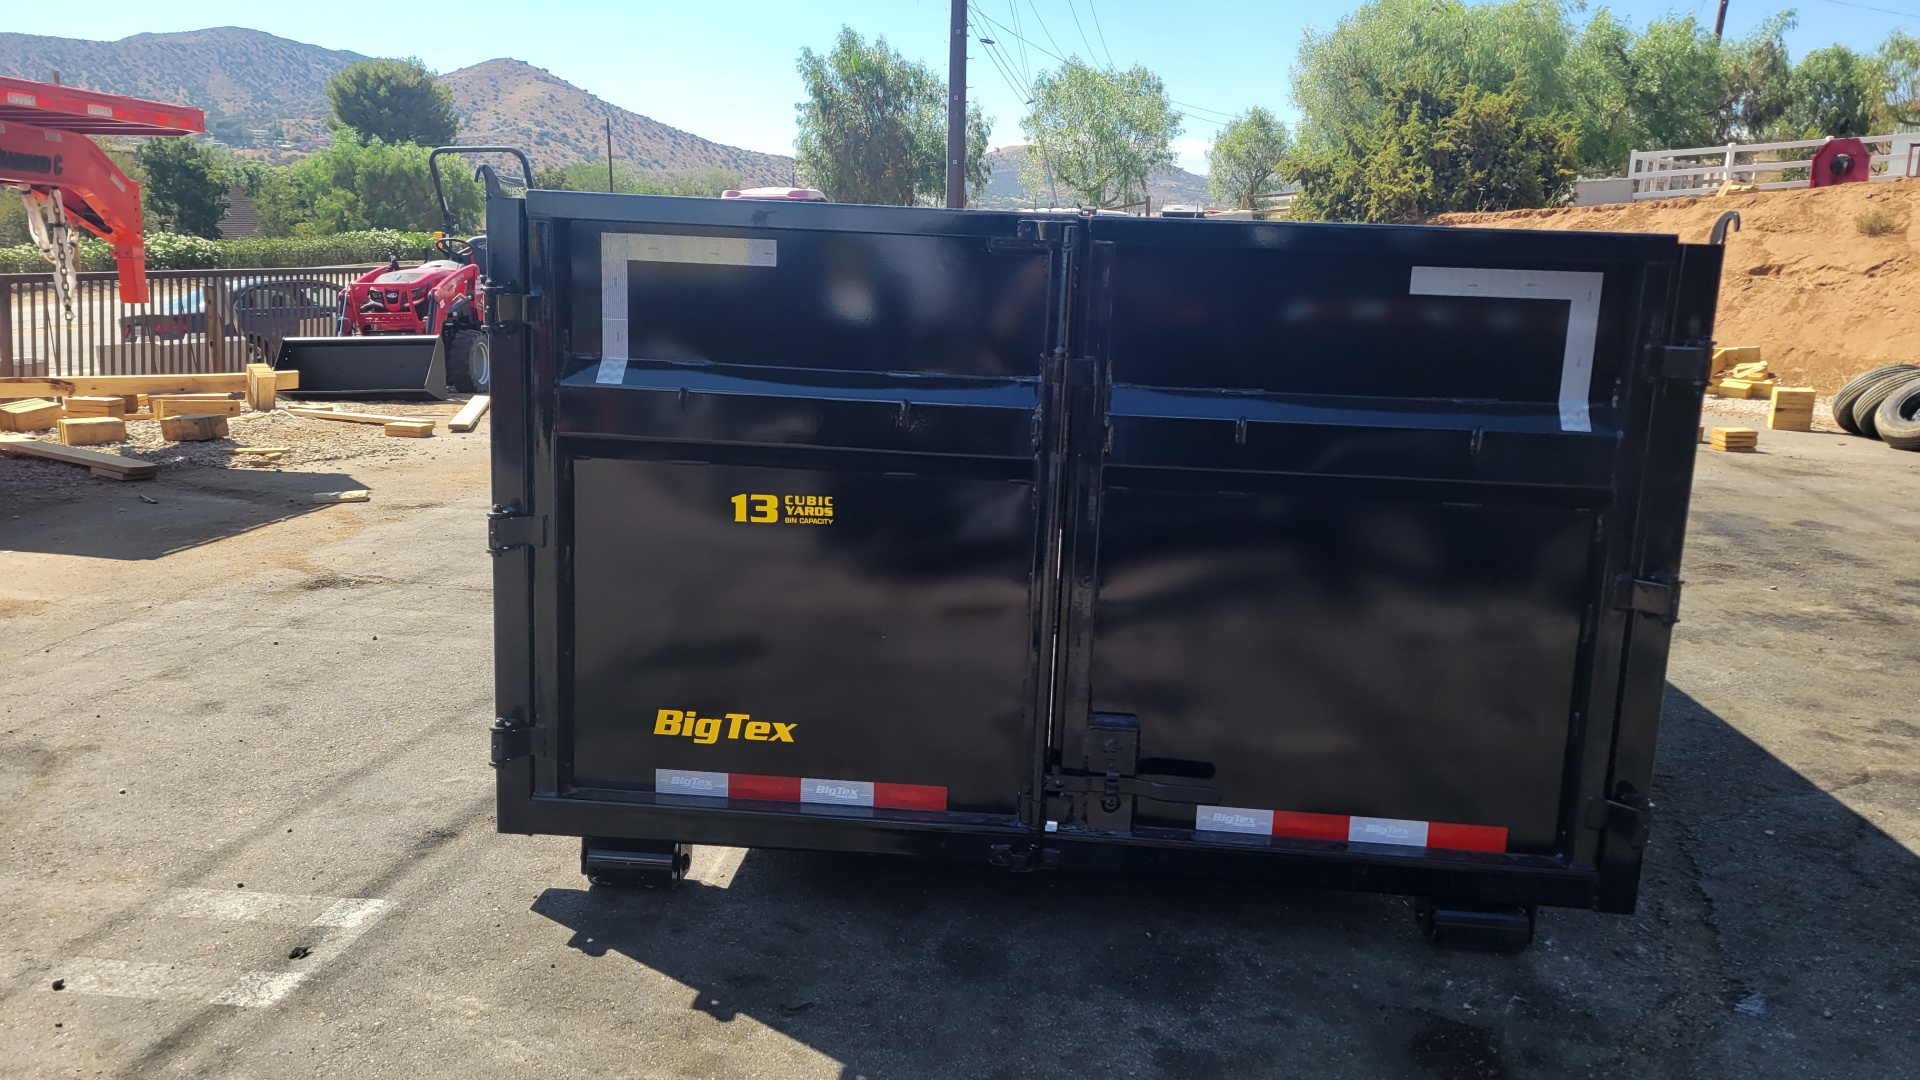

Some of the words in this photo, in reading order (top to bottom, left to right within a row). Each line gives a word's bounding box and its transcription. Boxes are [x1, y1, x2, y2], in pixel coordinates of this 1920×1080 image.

[785, 495, 833, 506] CUBIC
[731, 494, 779, 523] 13
[785, 506, 833, 516] YARDS
[799, 517, 834, 525] CAPACITY
[816, 785, 858, 796] BigTex
